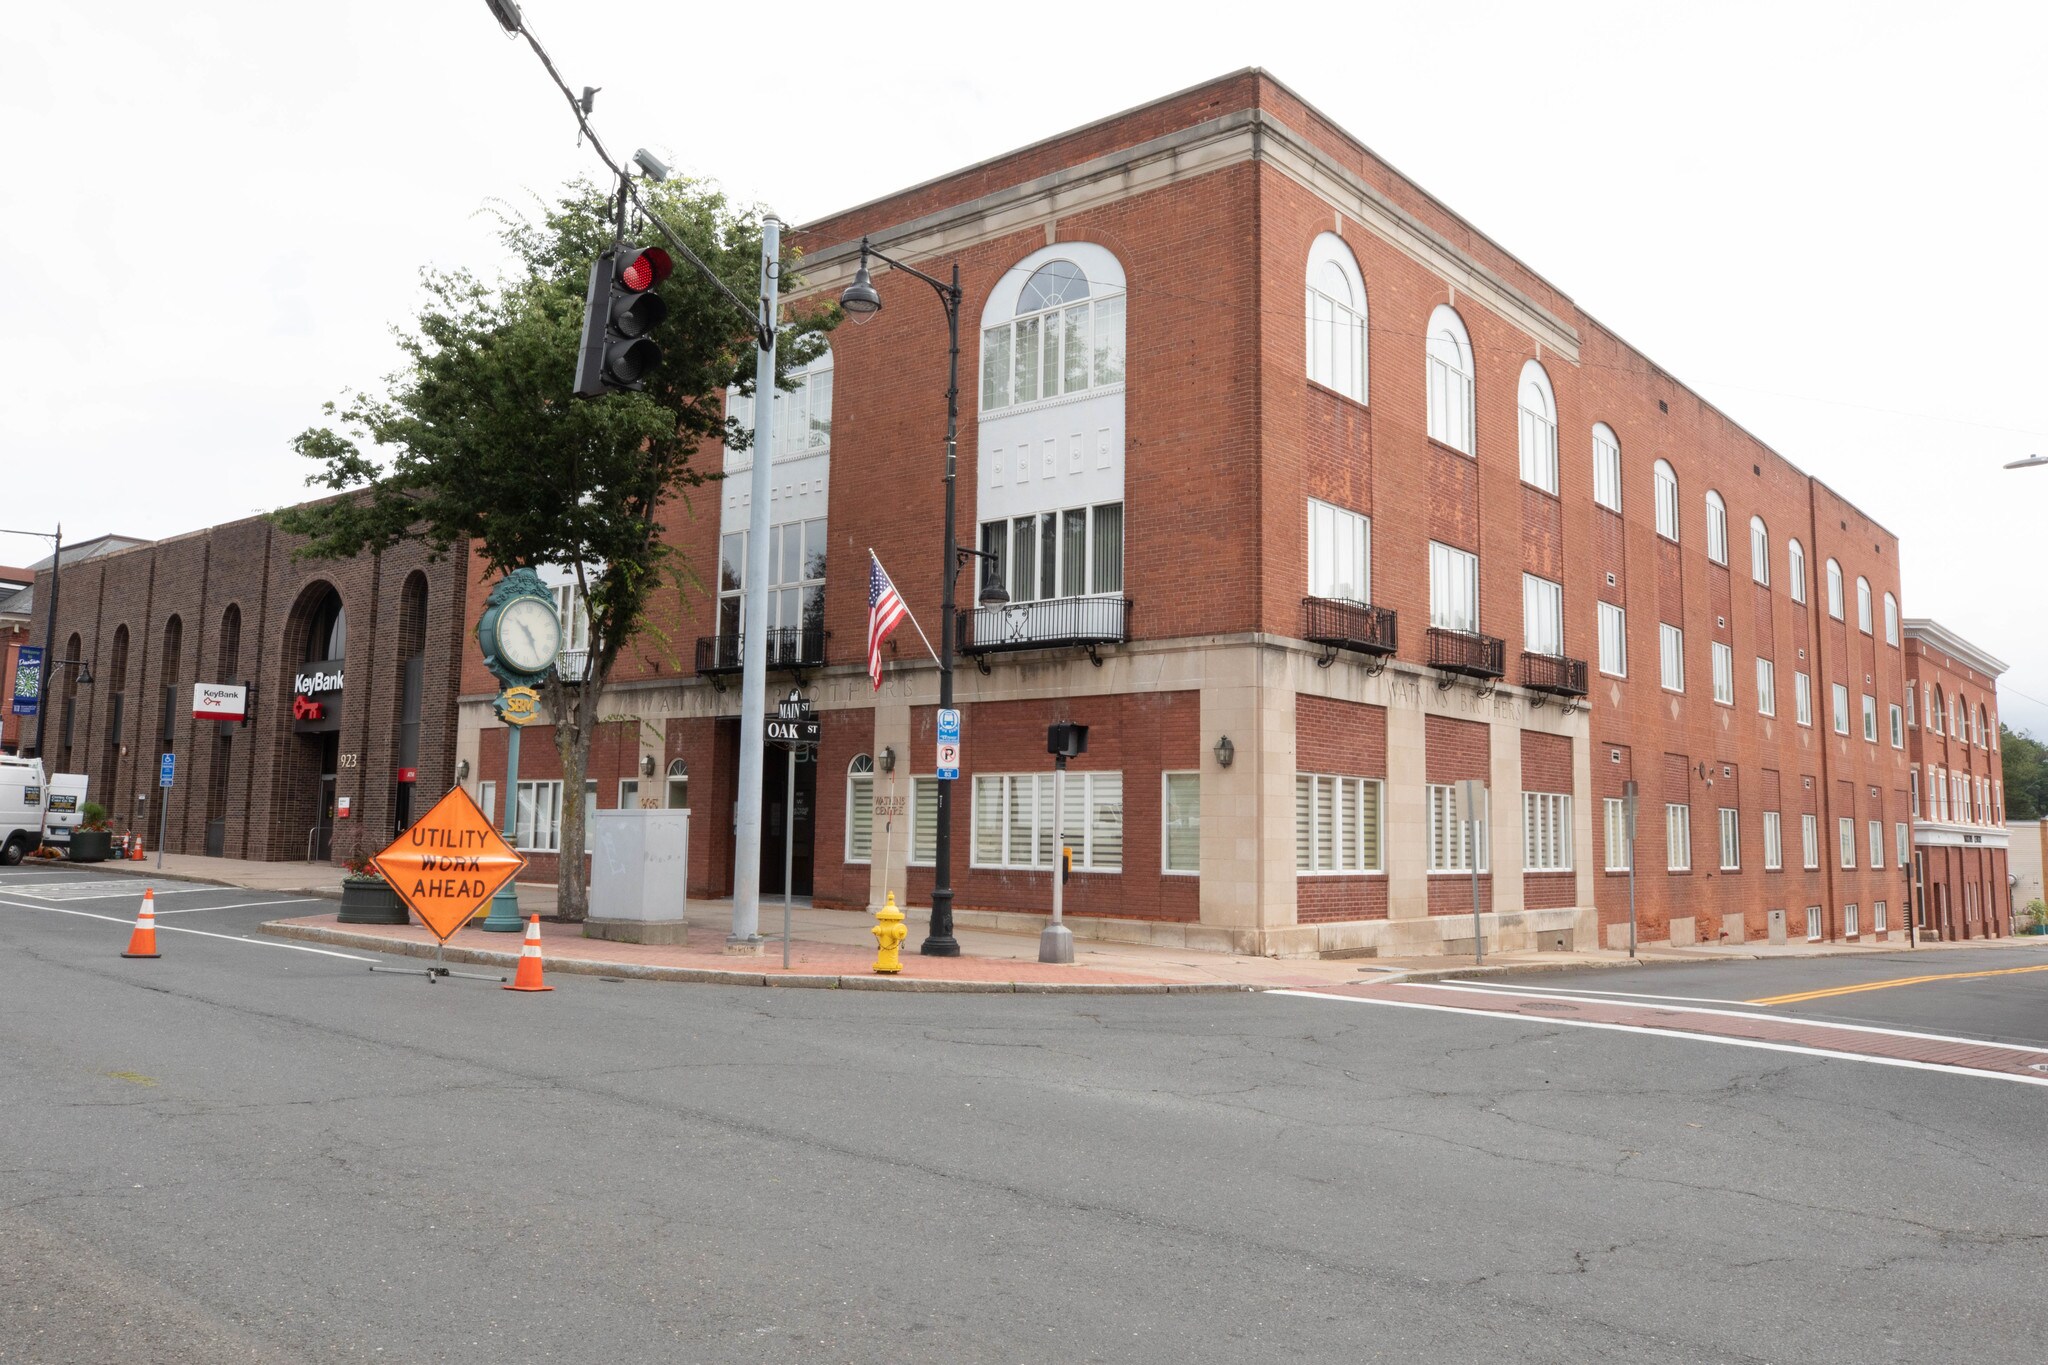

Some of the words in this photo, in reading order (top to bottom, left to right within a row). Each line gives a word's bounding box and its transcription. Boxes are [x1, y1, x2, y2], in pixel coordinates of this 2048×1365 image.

[294, 670, 344, 697] KeyBank
[203, 689, 239, 699] KeyBank
[1386, 679, 1448, 708] WATKINS
[1460, 693, 1522, 721] BROTHERS
[507, 697, 535, 713] SBM
[778, 703, 800, 719] MAIN
[801, 702, 810, 711] ST
[767, 722, 799, 739] OAK
[807, 724, 818, 734] ST
[340, 754, 357, 768] 923
[874, 796, 906, 806] WATKINS
[875, 806, 904, 816] CENTRE
[411, 827, 489, 849] UTILITY
[421, 854, 481, 873] WORK
[411, 879, 486, 898] AHEAD
